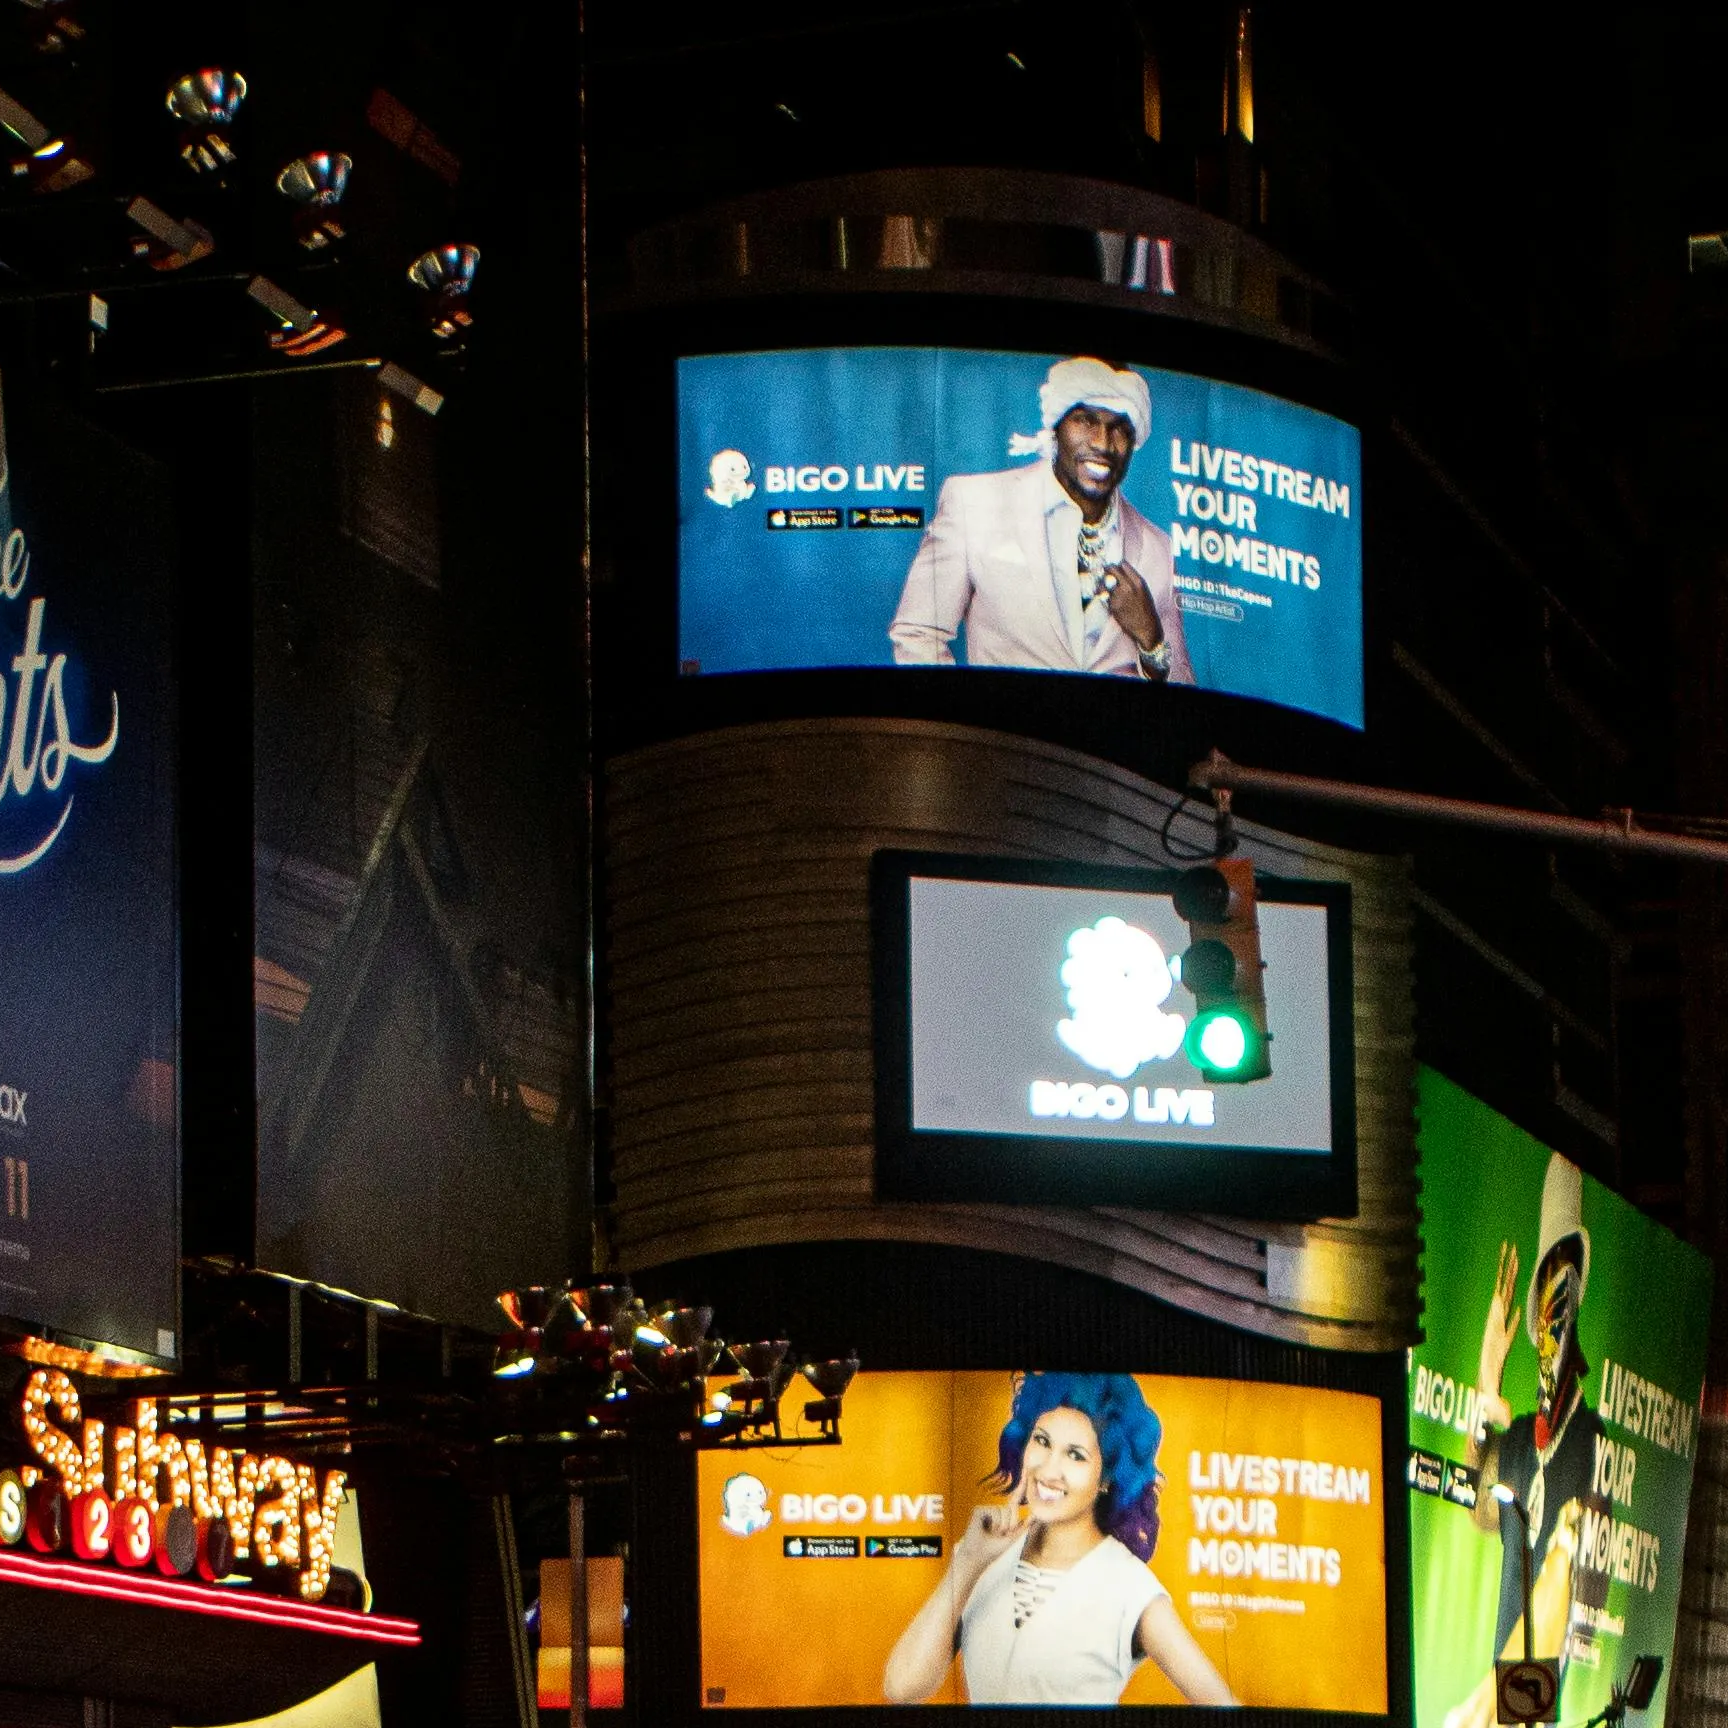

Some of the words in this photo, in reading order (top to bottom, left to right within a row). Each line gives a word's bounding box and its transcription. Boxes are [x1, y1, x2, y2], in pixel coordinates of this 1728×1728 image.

[765, 465, 849, 493] BIGO
[856, 464, 925, 491] LIVE
[1172, 438, 1350, 519] LIVESTREAM
[1172, 480, 1257, 532] YOUR
[1172, 522, 1320, 590] MOMENTS
[1030, 1080, 1130, 1119] BIGO
[1133, 1085, 1215, 1126] LIVE
[3, 1156, 29, 1220] 11
[1413, 1364, 1455, 1424] BIGO
[1455, 1386, 1488, 1441] LIVE
[1598, 1358, 1694, 1457] LIVESTREAM
[23, 1369, 347, 1600] Subway
[1190, 1450, 1370, 1504] LIVESTREAM
[1592, 1433, 1636, 1507] YOUR
[1, 1481, 21, 1528] S
[89, 1497, 109, 1551] 2
[130, 1504, 151, 1560] 3
[781, 1493, 867, 1523] BIGO
[873, 1494, 944, 1522] LIVE
[1191, 1495, 1277, 1536] YOUR
[808, 1544, 828, 1557] App
[829, 1544, 855, 1555] Store
[888, 1544, 920, 1557] Google
[921, 1544, 938, 1555] Play
[1189, 1537, 1341, 1586] MOMENTS
[1580, 1509, 1660, 1592] MOMENTS
